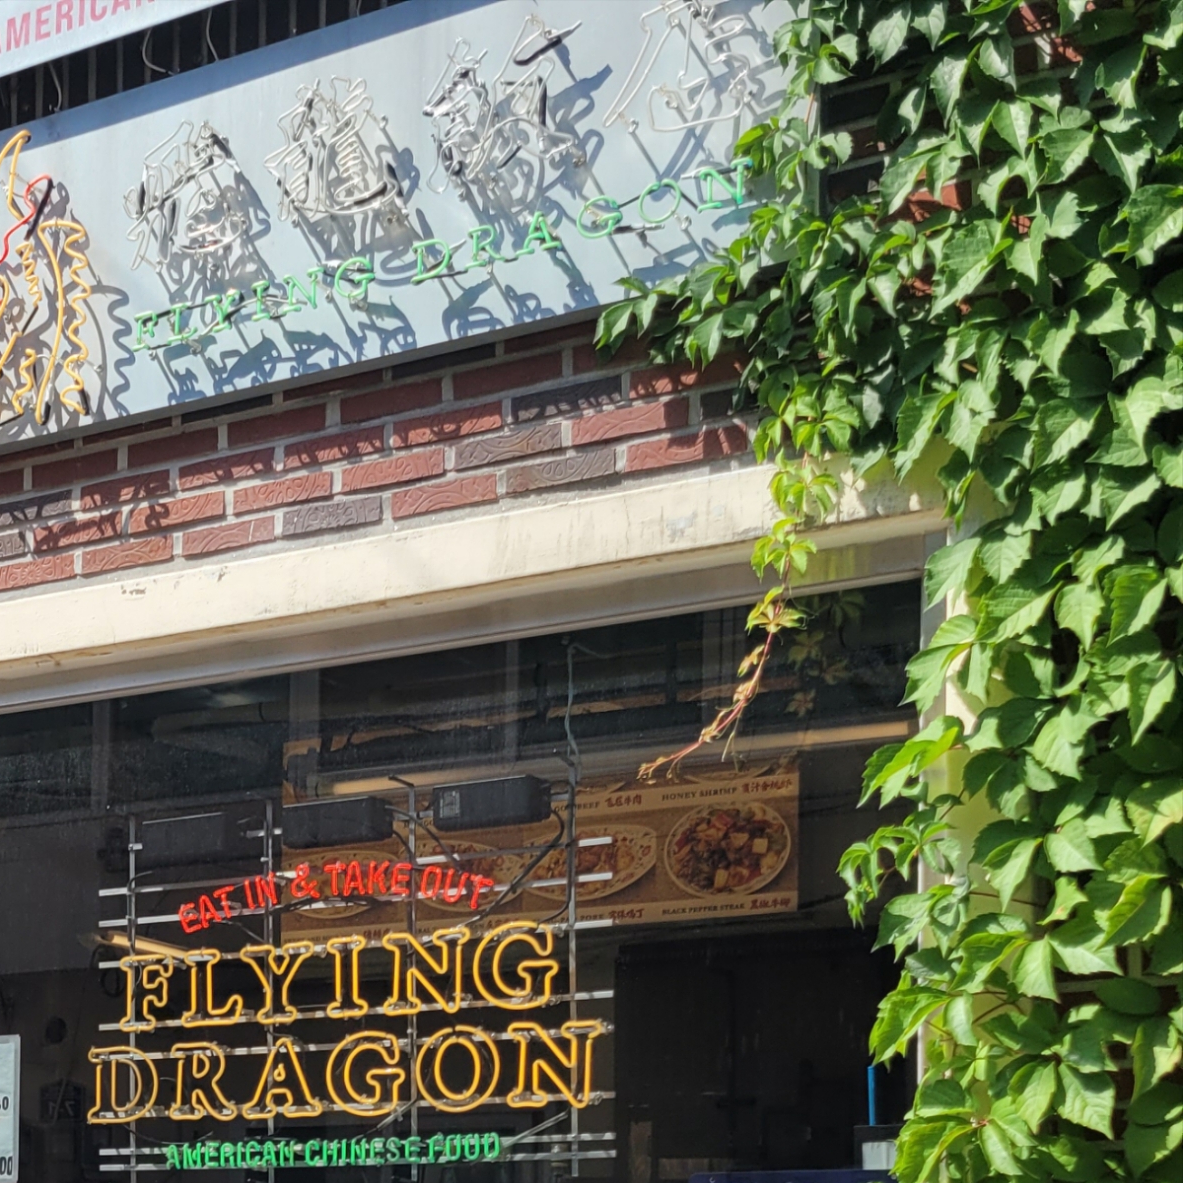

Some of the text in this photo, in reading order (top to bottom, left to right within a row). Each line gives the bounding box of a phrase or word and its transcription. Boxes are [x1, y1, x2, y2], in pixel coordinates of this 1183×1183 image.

[133, 156, 755, 352] FLYING DRAGON
[661, 786, 738, 802] HONEY SHRIMP
[178, 861, 494, 934] EAT IN & TAKE OUT
[119, 920, 559, 1032] FLYING
[87, 1018, 601, 1124] DRAGON
[166, 1131, 501, 1170] AMERICAN CHINESE FOOD
